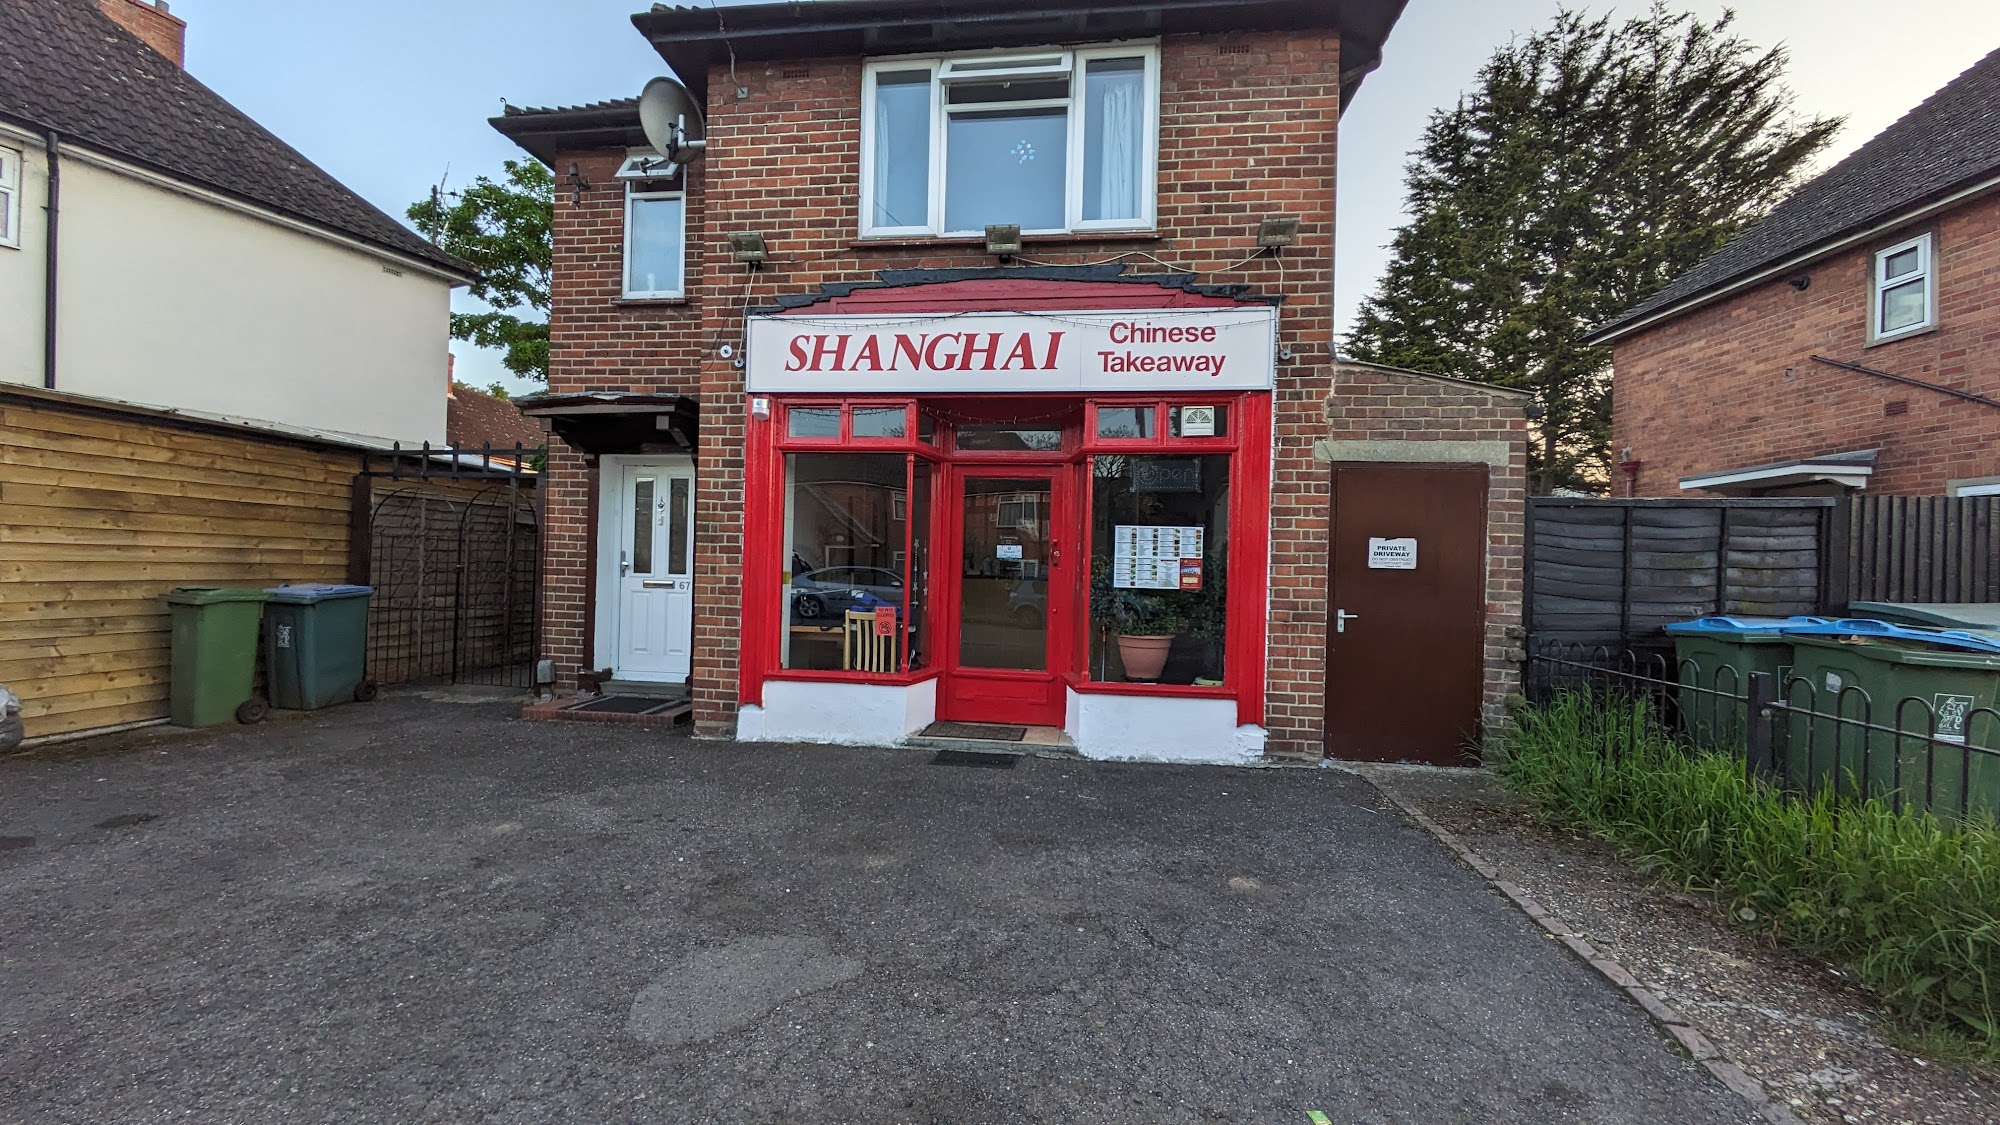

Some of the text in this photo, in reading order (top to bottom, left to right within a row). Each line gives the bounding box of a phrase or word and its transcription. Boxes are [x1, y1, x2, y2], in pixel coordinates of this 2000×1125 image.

[1109, 321, 1217, 344] Chinese
[784, 330, 1066, 372] SHANGHAI
[1097, 350, 1227, 377] Takeaway
[679, 581, 691, 591] 67
